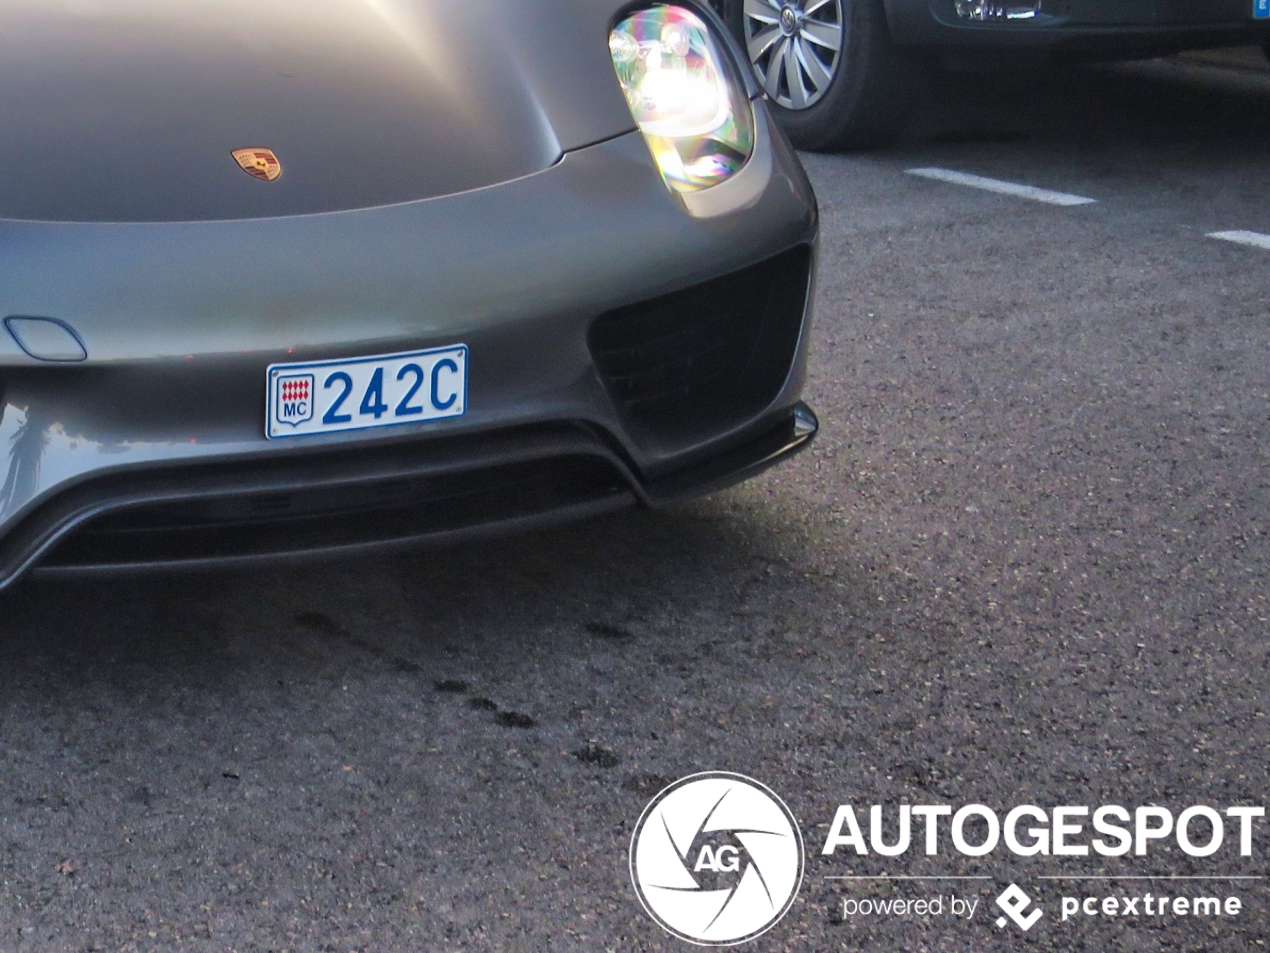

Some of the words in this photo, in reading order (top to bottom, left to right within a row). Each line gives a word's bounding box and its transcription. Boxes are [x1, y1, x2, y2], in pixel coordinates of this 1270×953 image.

[1258, 0, 1267, 10] E
[283, 402, 307, 417] MC
[322, 358, 459, 425] 242C
